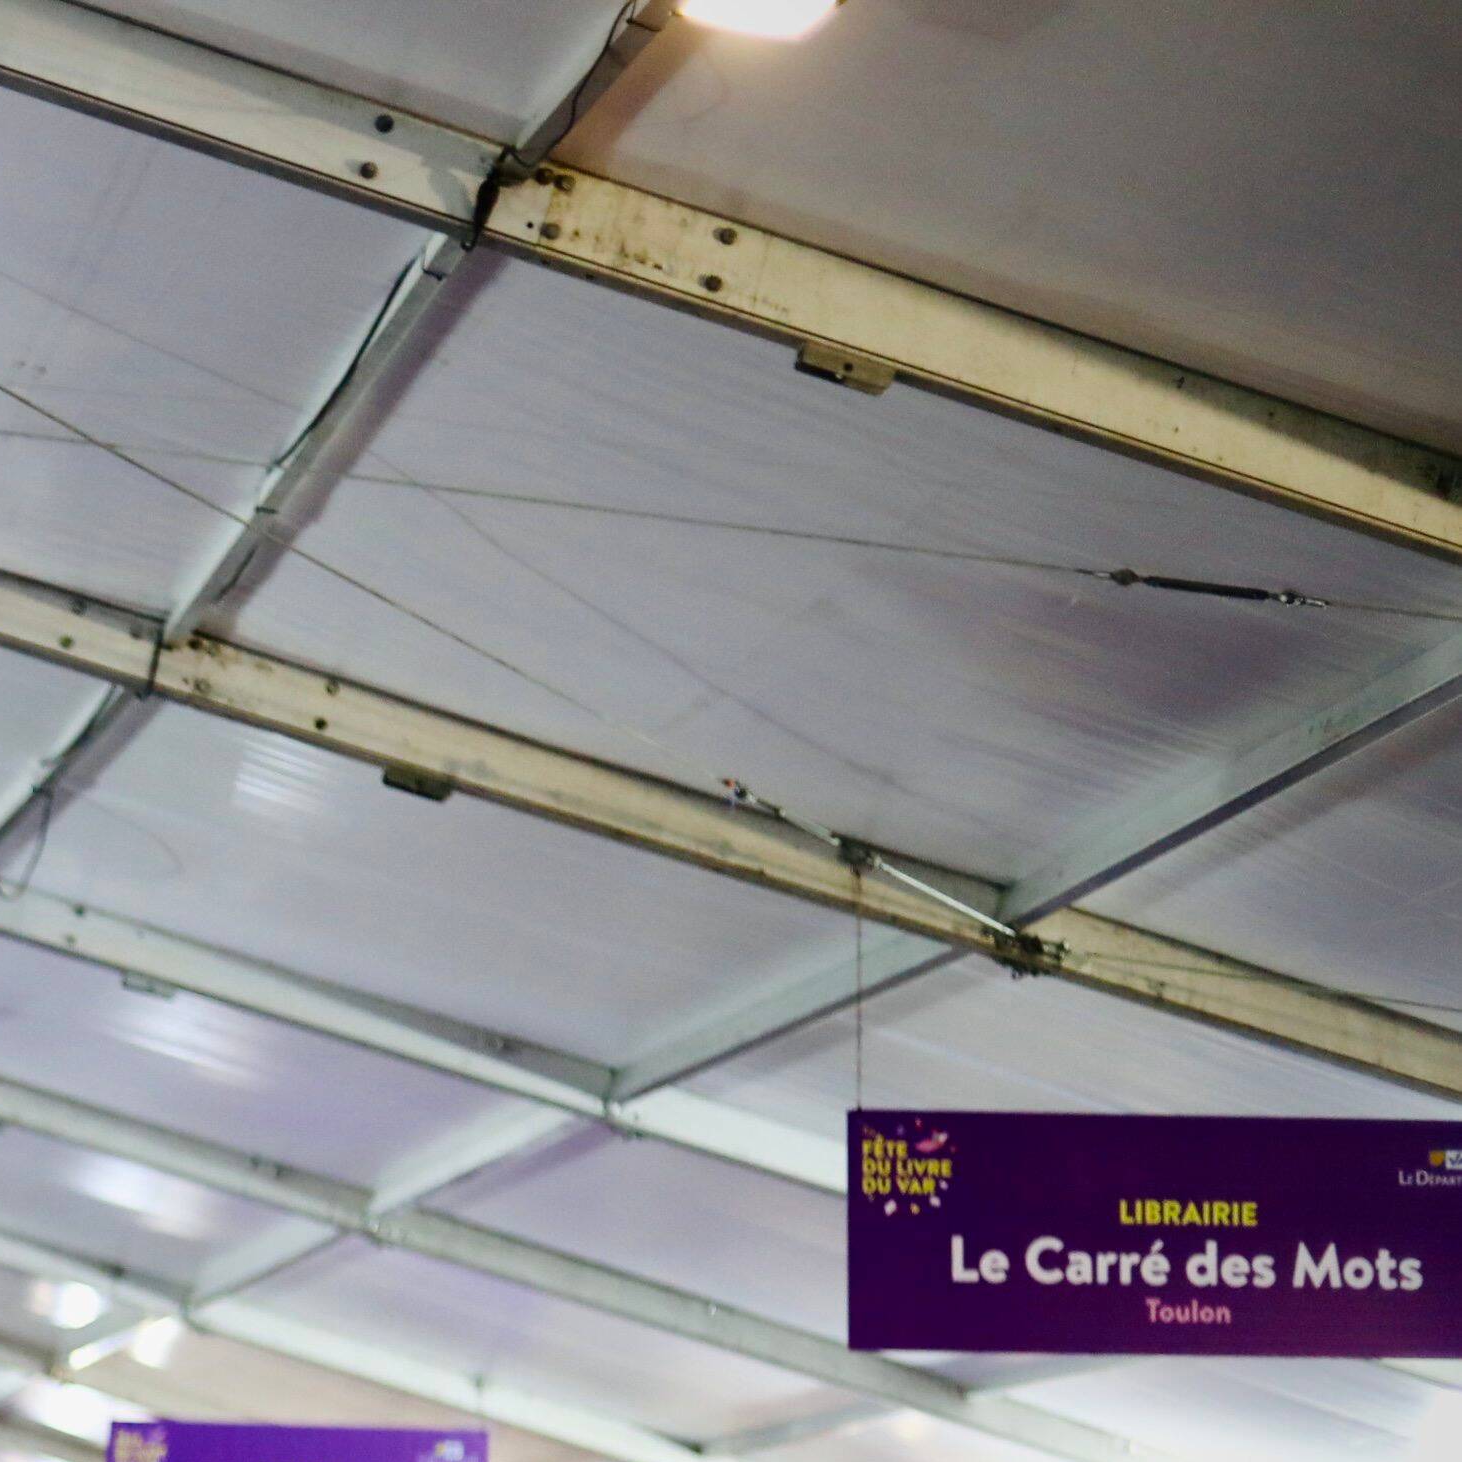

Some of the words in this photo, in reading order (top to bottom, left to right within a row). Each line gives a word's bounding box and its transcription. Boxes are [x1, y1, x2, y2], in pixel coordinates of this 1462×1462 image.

[862, 1134, 907, 1158] FÊTE
[862, 1158, 891, 1176] DU
[896, 1158, 952, 1178] LIVRE
[862, 1176, 891, 1195] DU
[896, 1176, 935, 1195] VAR
[1118, 1199, 1259, 1228] LIBRAIRIE
[951, 1234, 1009, 1284] Le
[1025, 1236, 1171, 1288] Carré
[1186, 1240, 1276, 1289] des
[1293, 1241, 1424, 1292] Mots
[1146, 1298, 1231, 1325] Toulon
